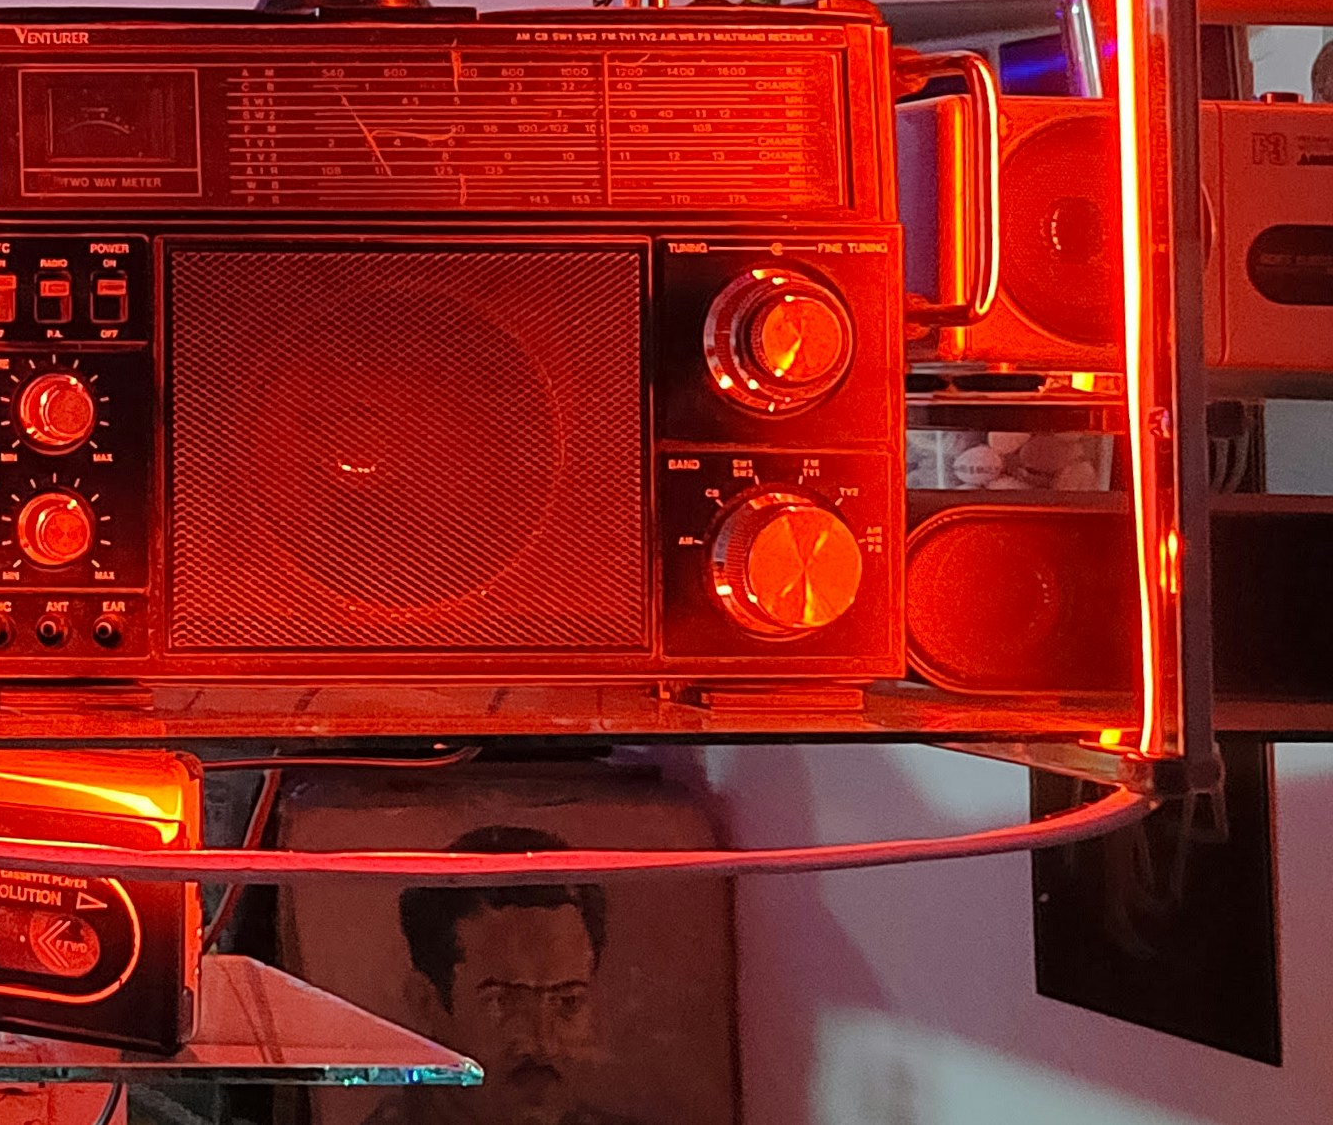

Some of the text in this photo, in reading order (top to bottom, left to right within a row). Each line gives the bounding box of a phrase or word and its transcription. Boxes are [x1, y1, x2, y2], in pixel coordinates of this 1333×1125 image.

[64, 177, 162, 188] TWO WAY METER
[90, 243, 130, 254] POWER
[668, 242, 888, 254] TUNING FINE TUNING
[40, 259, 68, 268] RADIO
[102, 259, 117, 268] ON
[100, 329, 119, 339] OFF
[93, 453, 113, 462] MAX
[668, 459, 701, 470] BAND
[94, 571, 115, 581] MAX
[46, 601, 69, 612] ANT
[102, 601, 126, 612] EAR
[0, 870, 50, 884] CASSETTE
[52, 875, 88, 889] PLAYER
